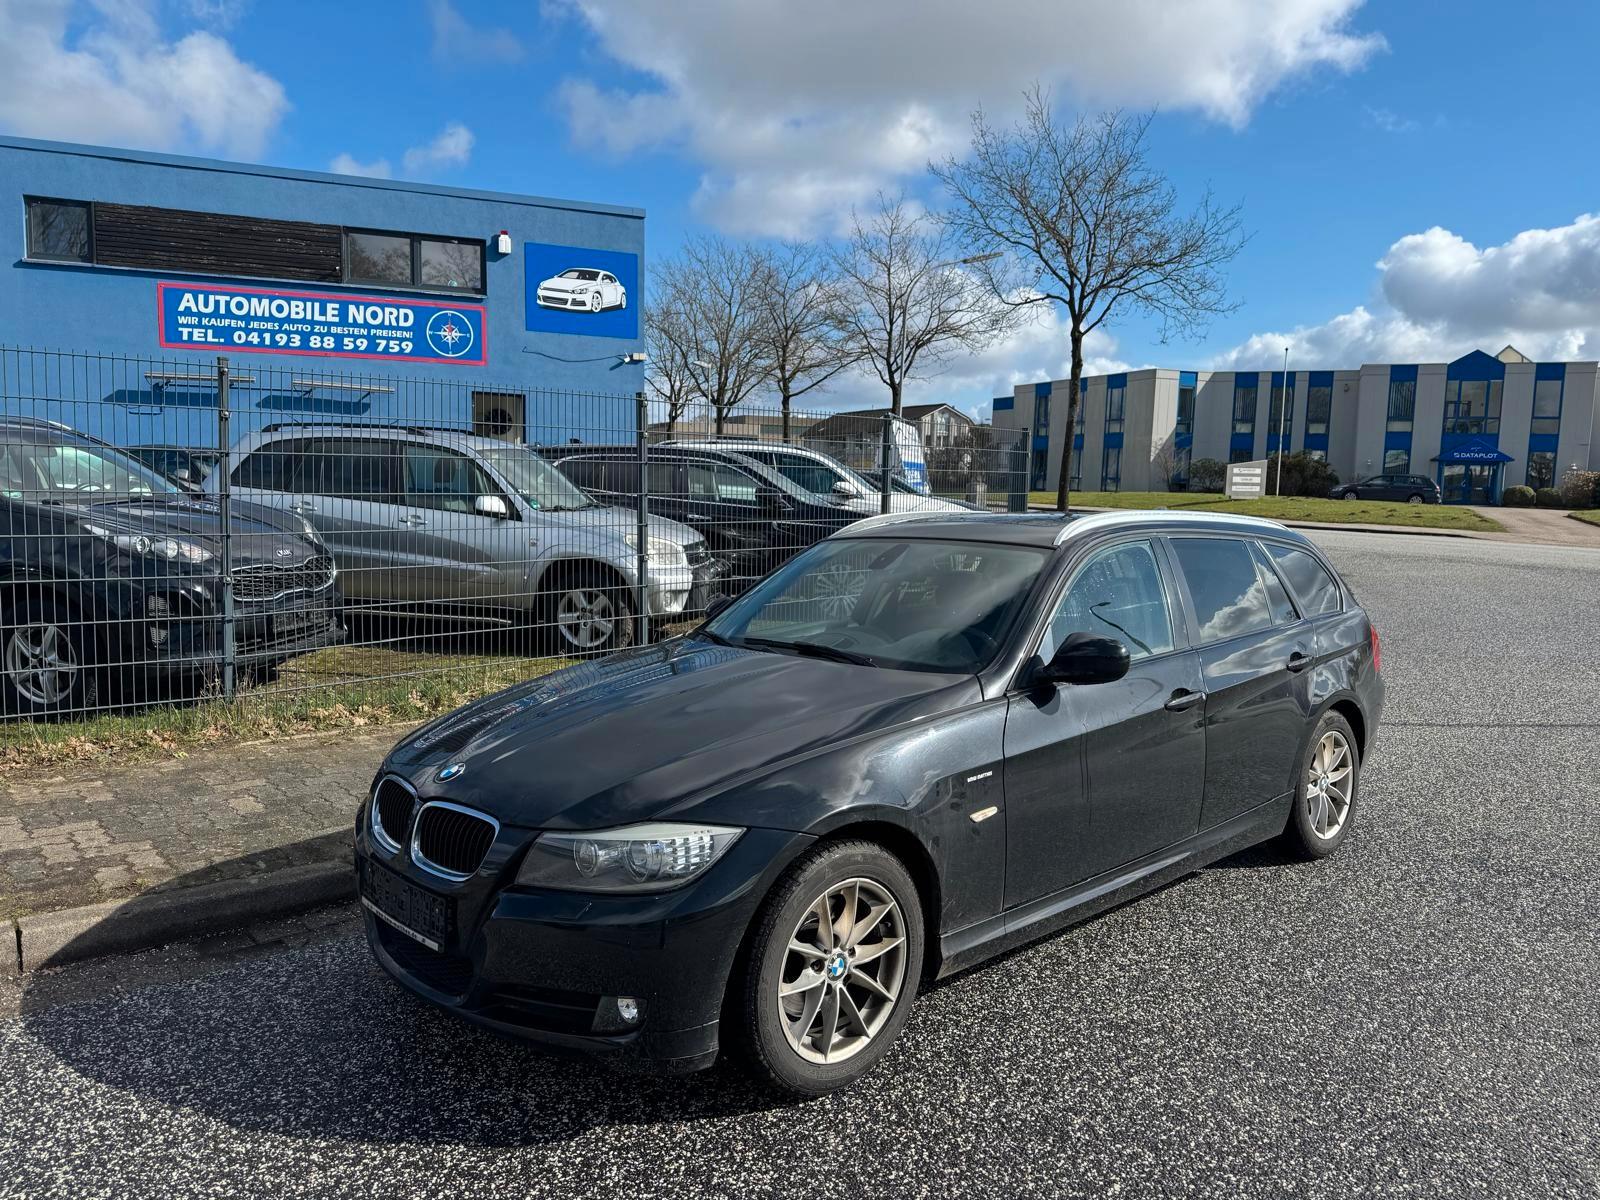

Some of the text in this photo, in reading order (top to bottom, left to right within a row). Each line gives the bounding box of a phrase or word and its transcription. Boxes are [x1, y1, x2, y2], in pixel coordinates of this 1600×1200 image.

[178, 293, 414, 327] AUTOMOBILE NORD
[178, 316, 413, 339] WIR KAUFEN JEDES AUTO ZU BESTEN PREISEN!
[178, 327, 413, 354] TEL. 04193 88 59 759
